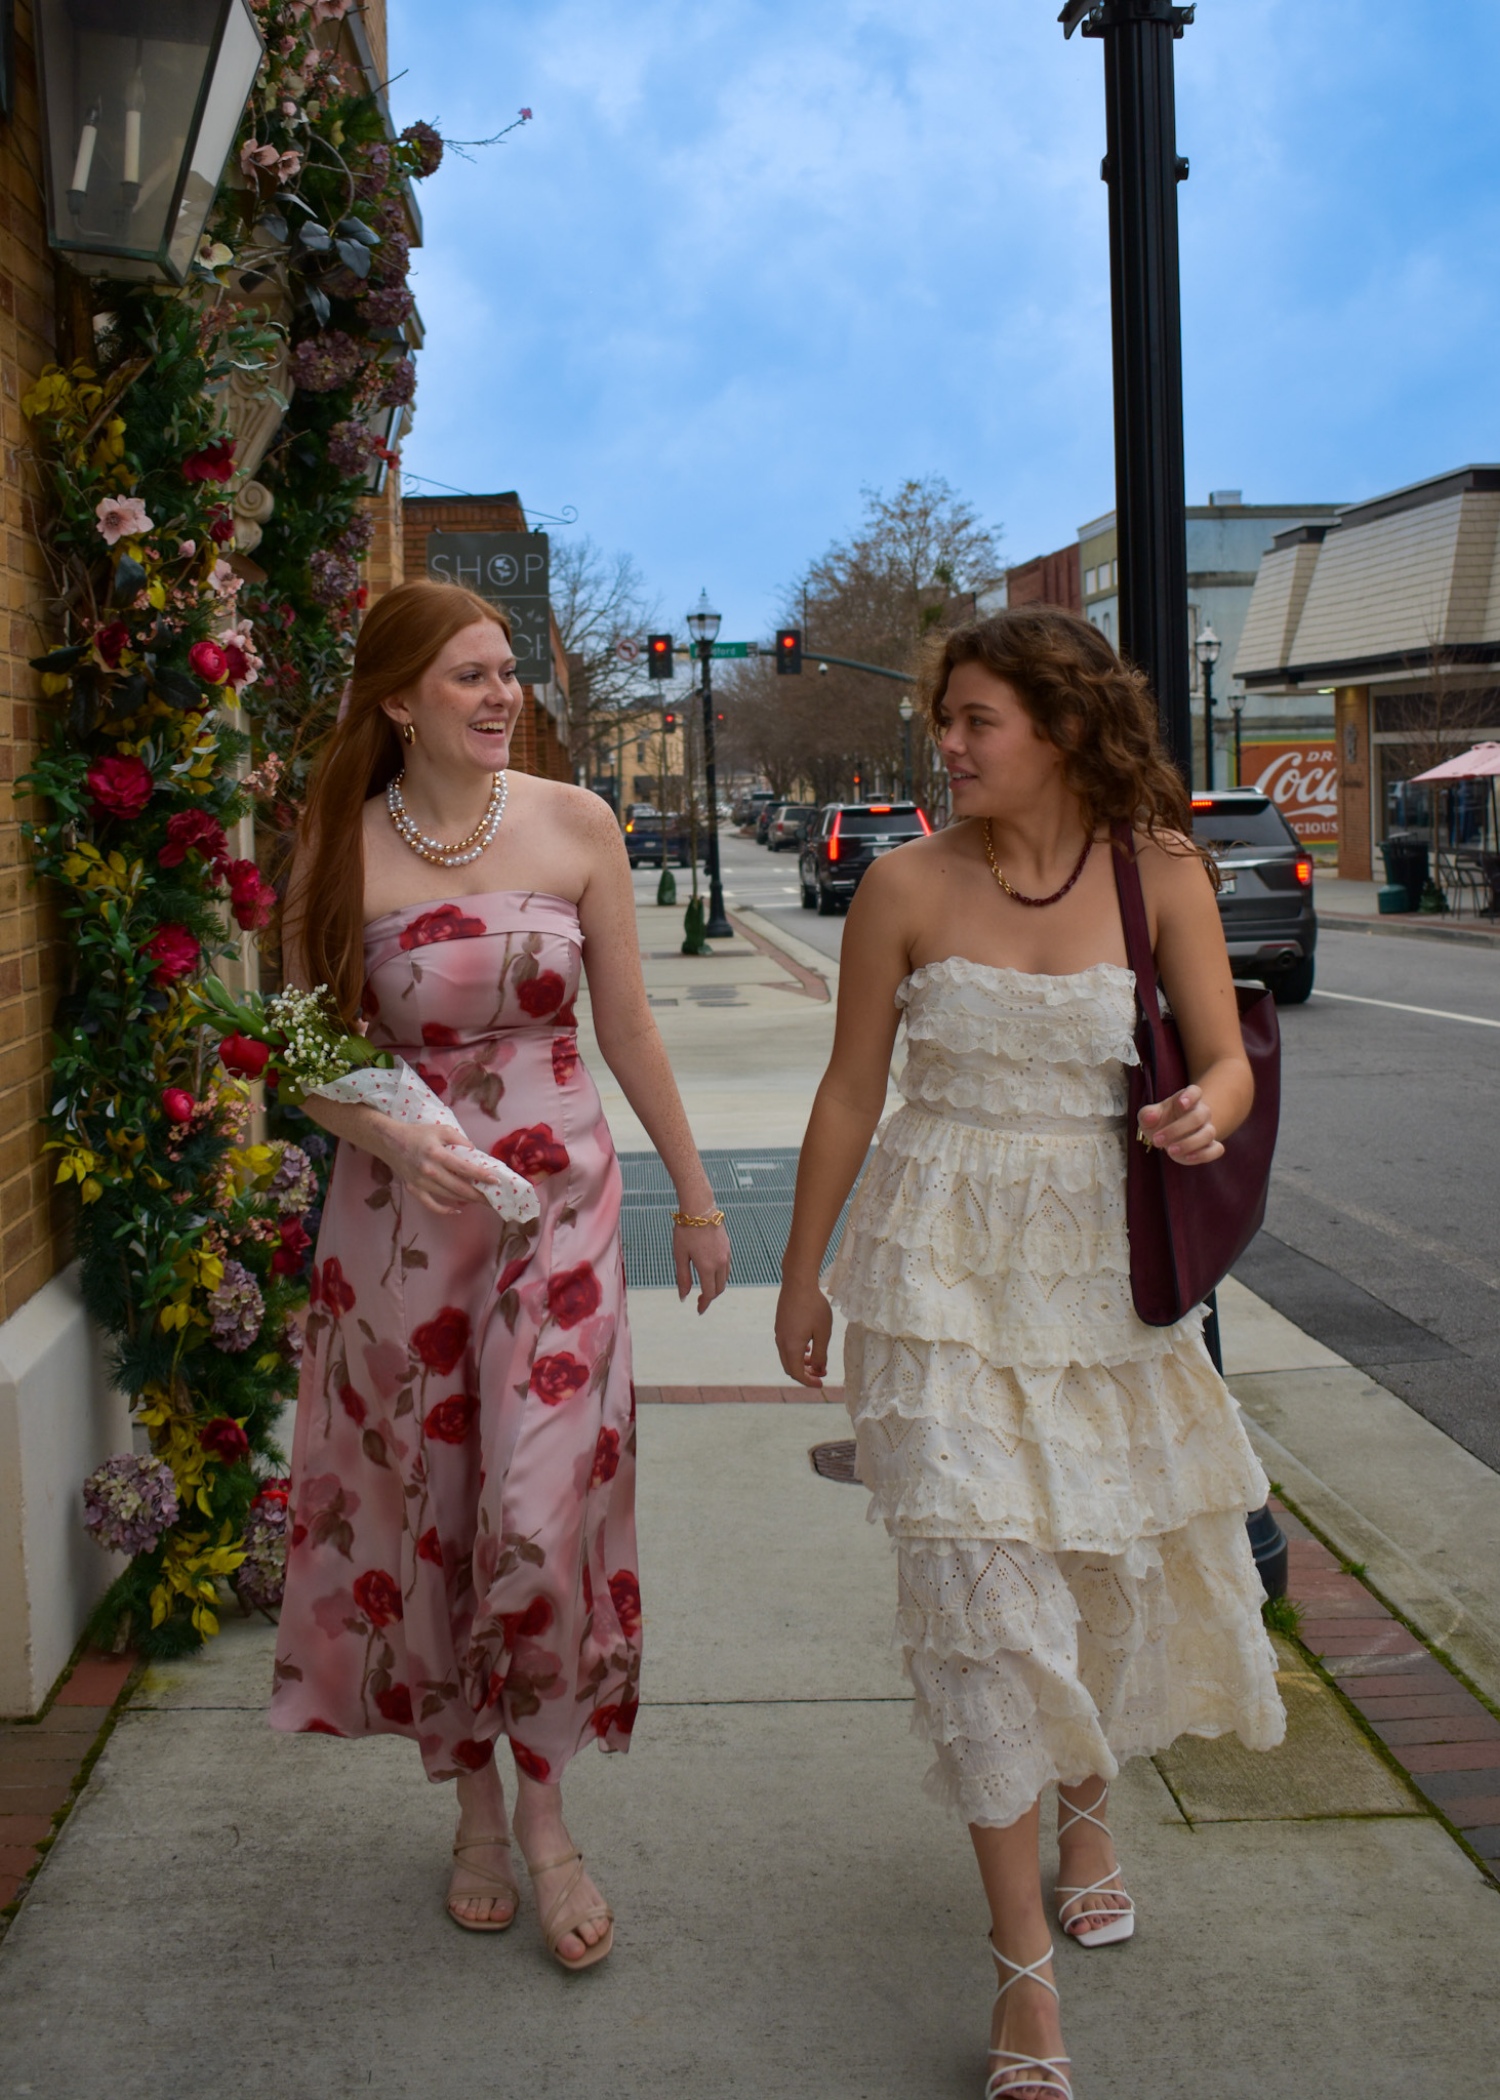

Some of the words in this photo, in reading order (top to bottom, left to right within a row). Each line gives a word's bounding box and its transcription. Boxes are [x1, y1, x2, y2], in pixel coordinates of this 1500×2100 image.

[431, 553, 545, 585] SHOP
[1254, 751, 1337, 804] Coca
[1291, 821, 1337, 835] CIOUS
